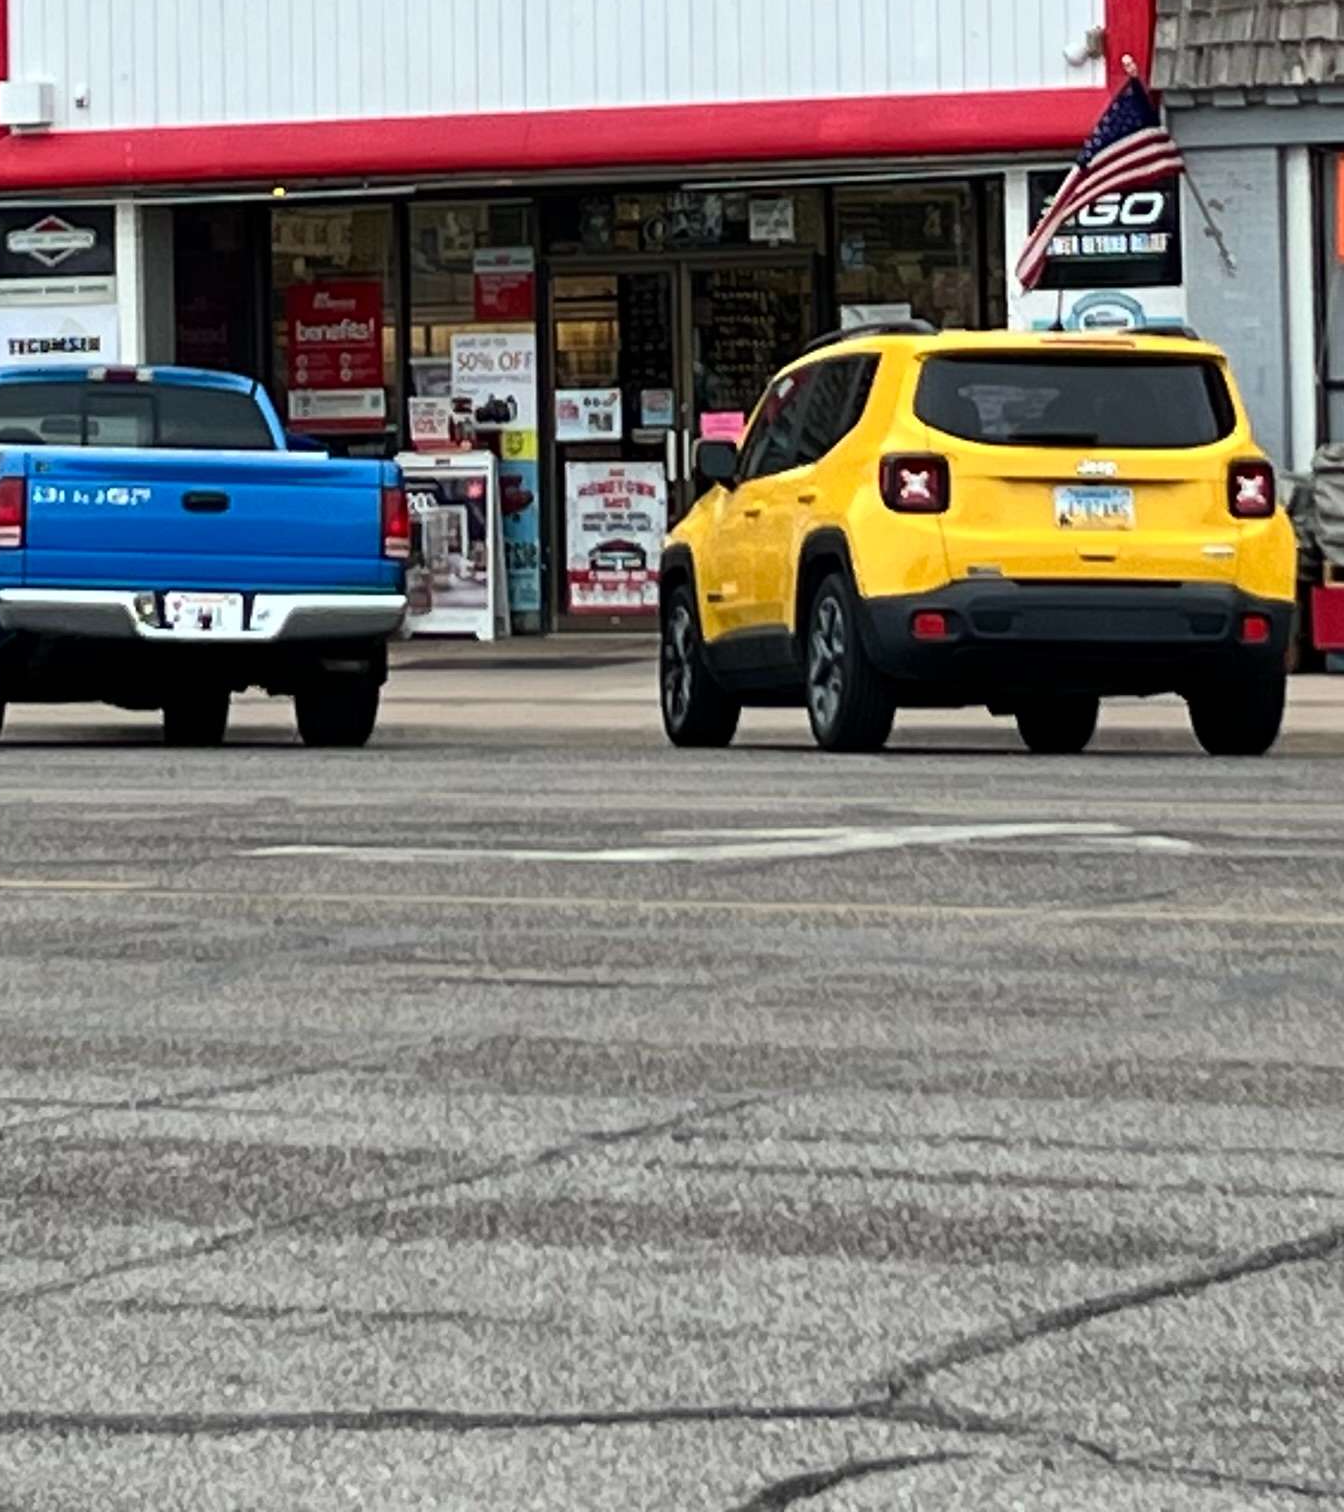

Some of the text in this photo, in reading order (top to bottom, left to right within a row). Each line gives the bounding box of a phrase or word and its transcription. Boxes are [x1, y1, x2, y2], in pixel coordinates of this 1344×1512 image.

[1046, 192, 1164, 226] GO
[457, 348, 533, 373] 50% OFF
